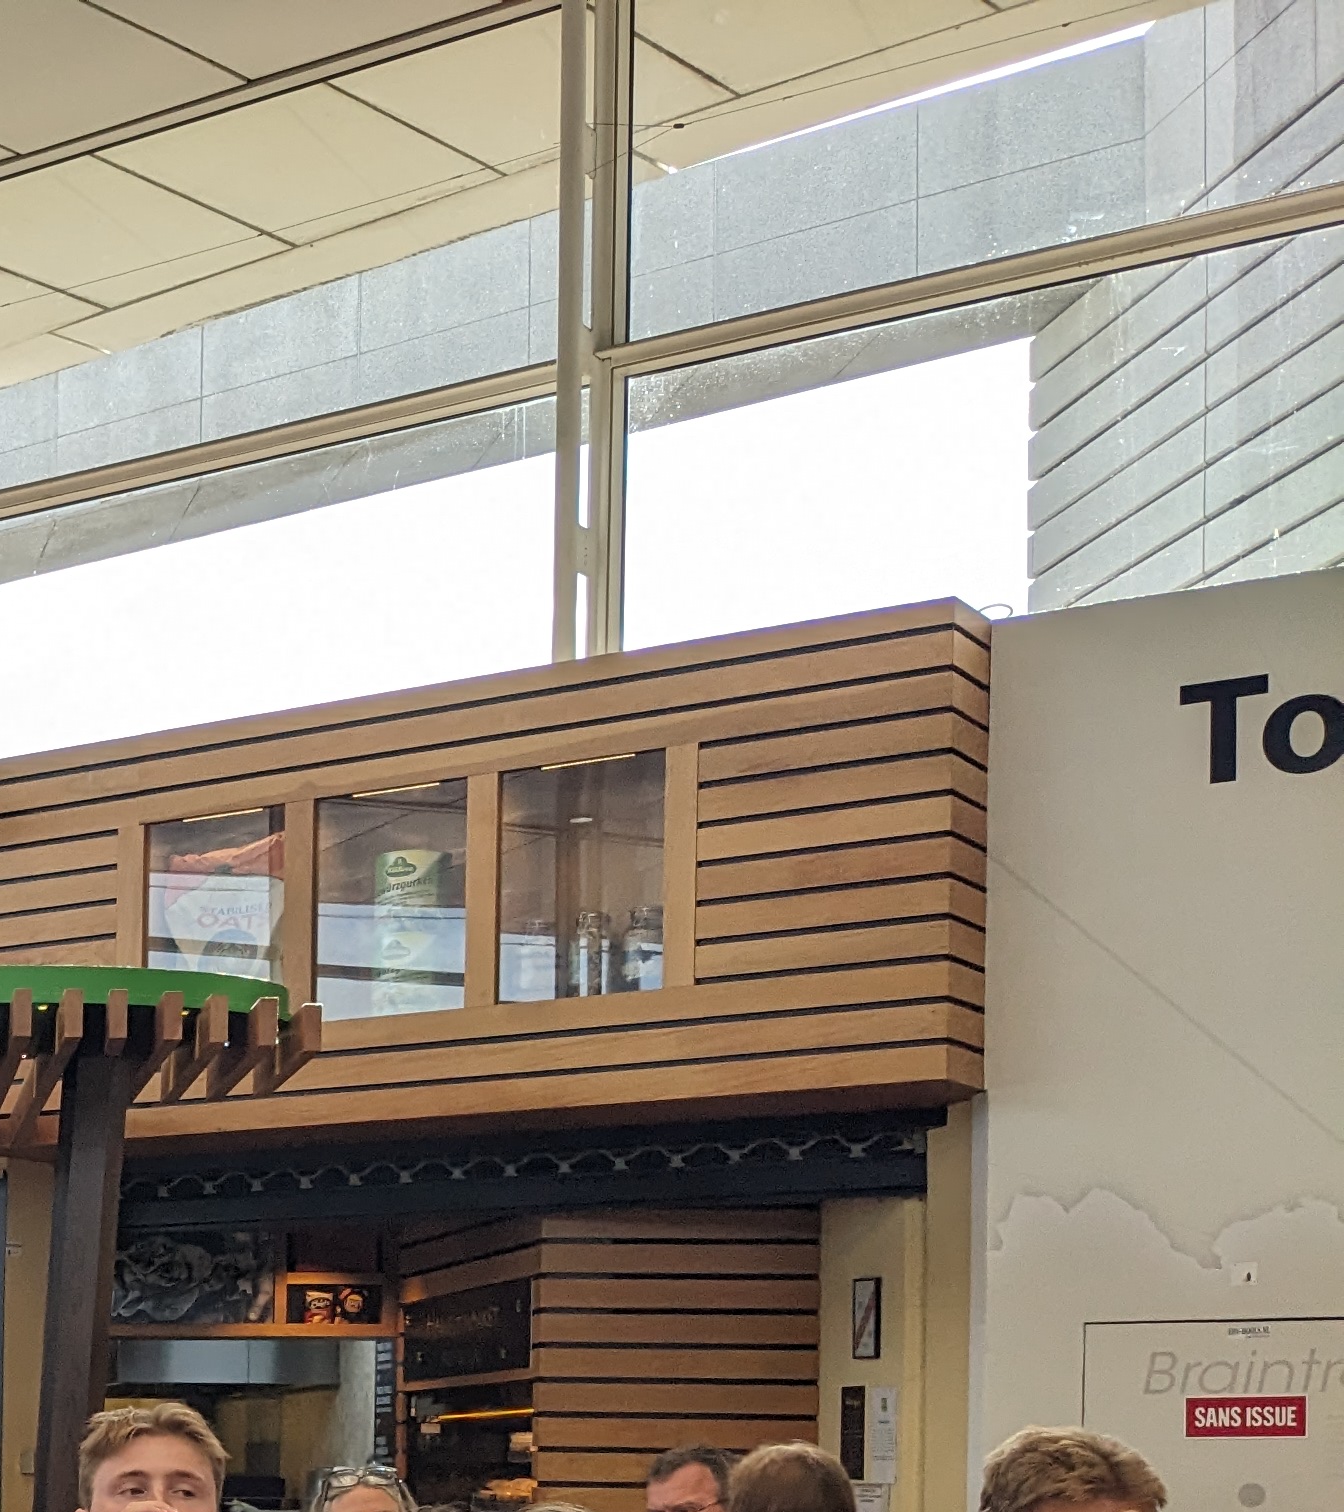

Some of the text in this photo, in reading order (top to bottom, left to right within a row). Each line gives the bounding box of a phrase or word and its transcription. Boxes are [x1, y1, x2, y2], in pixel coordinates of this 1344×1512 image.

[1143, 1348, 1344, 1395] Braintr
[1194, 1405, 1298, 1428] SANS ISSUE
